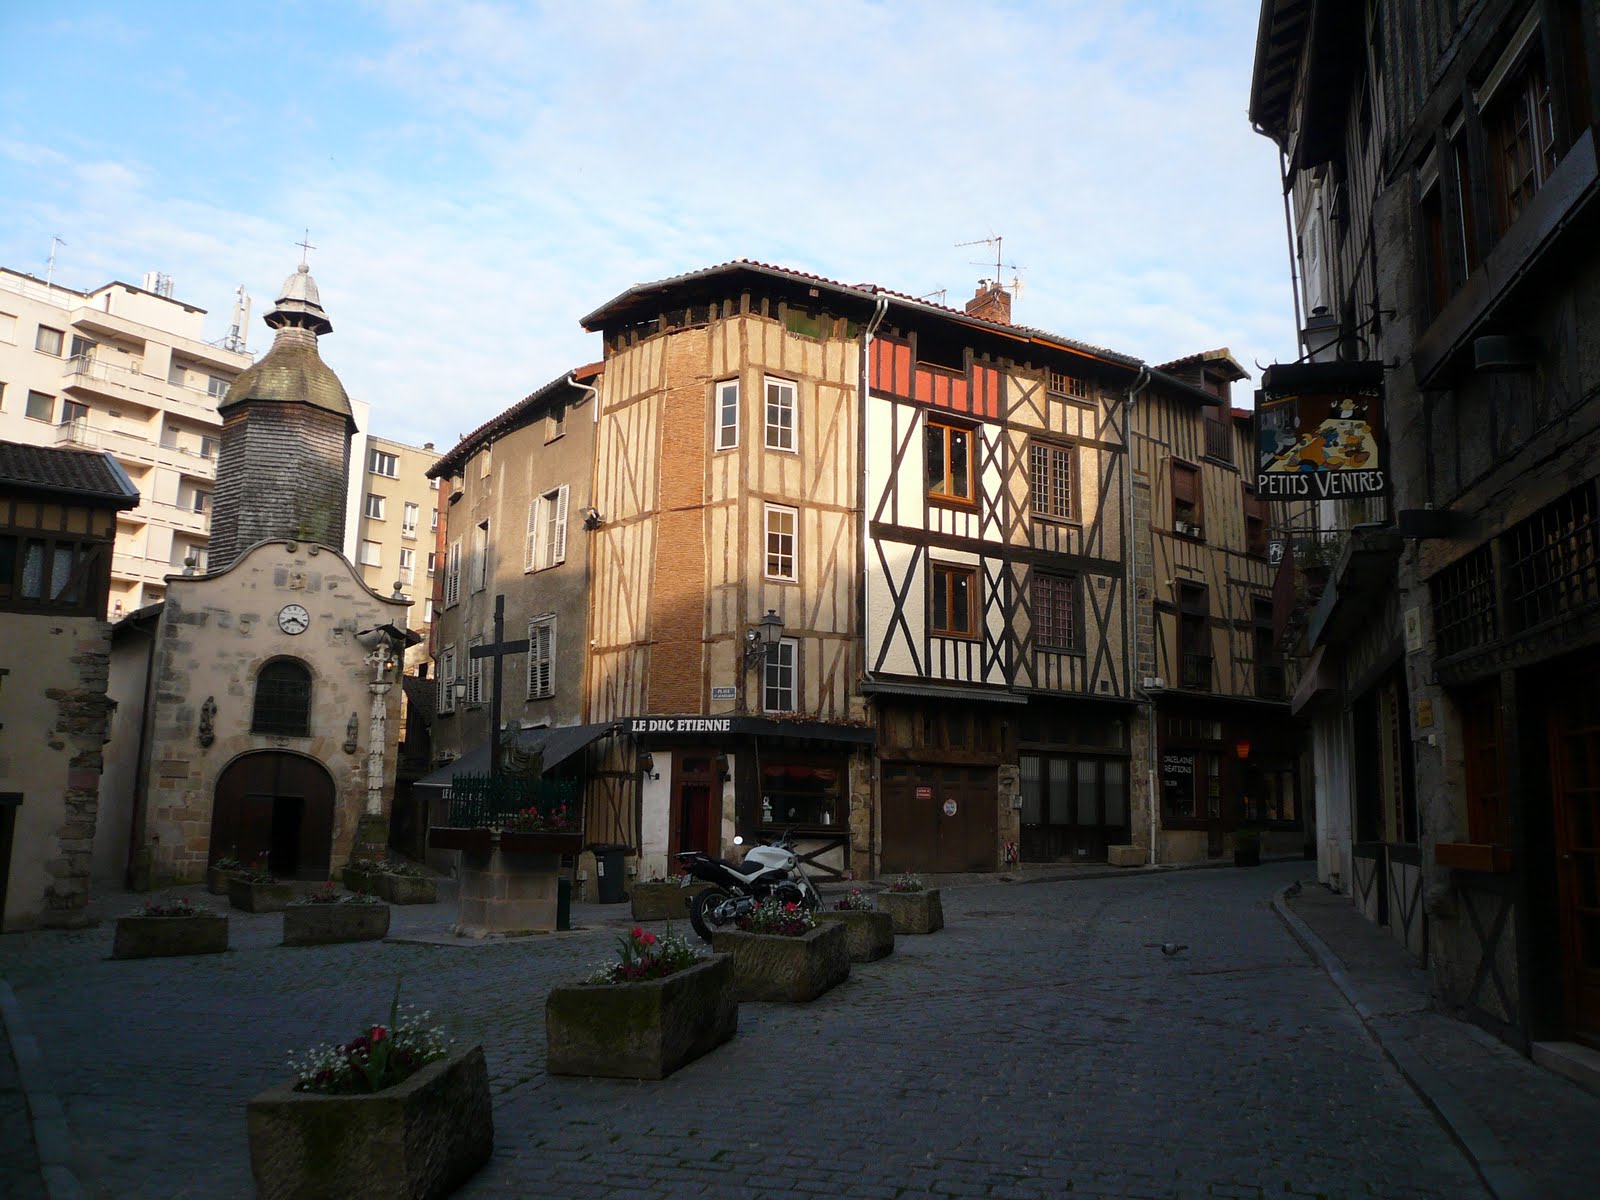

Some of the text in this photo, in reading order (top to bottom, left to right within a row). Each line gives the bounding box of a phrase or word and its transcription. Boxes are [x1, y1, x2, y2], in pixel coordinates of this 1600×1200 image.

[1258, 471, 1384, 498] PETITS VENTRES
[631, 719, 731, 732] LE DUC ETIENNE
